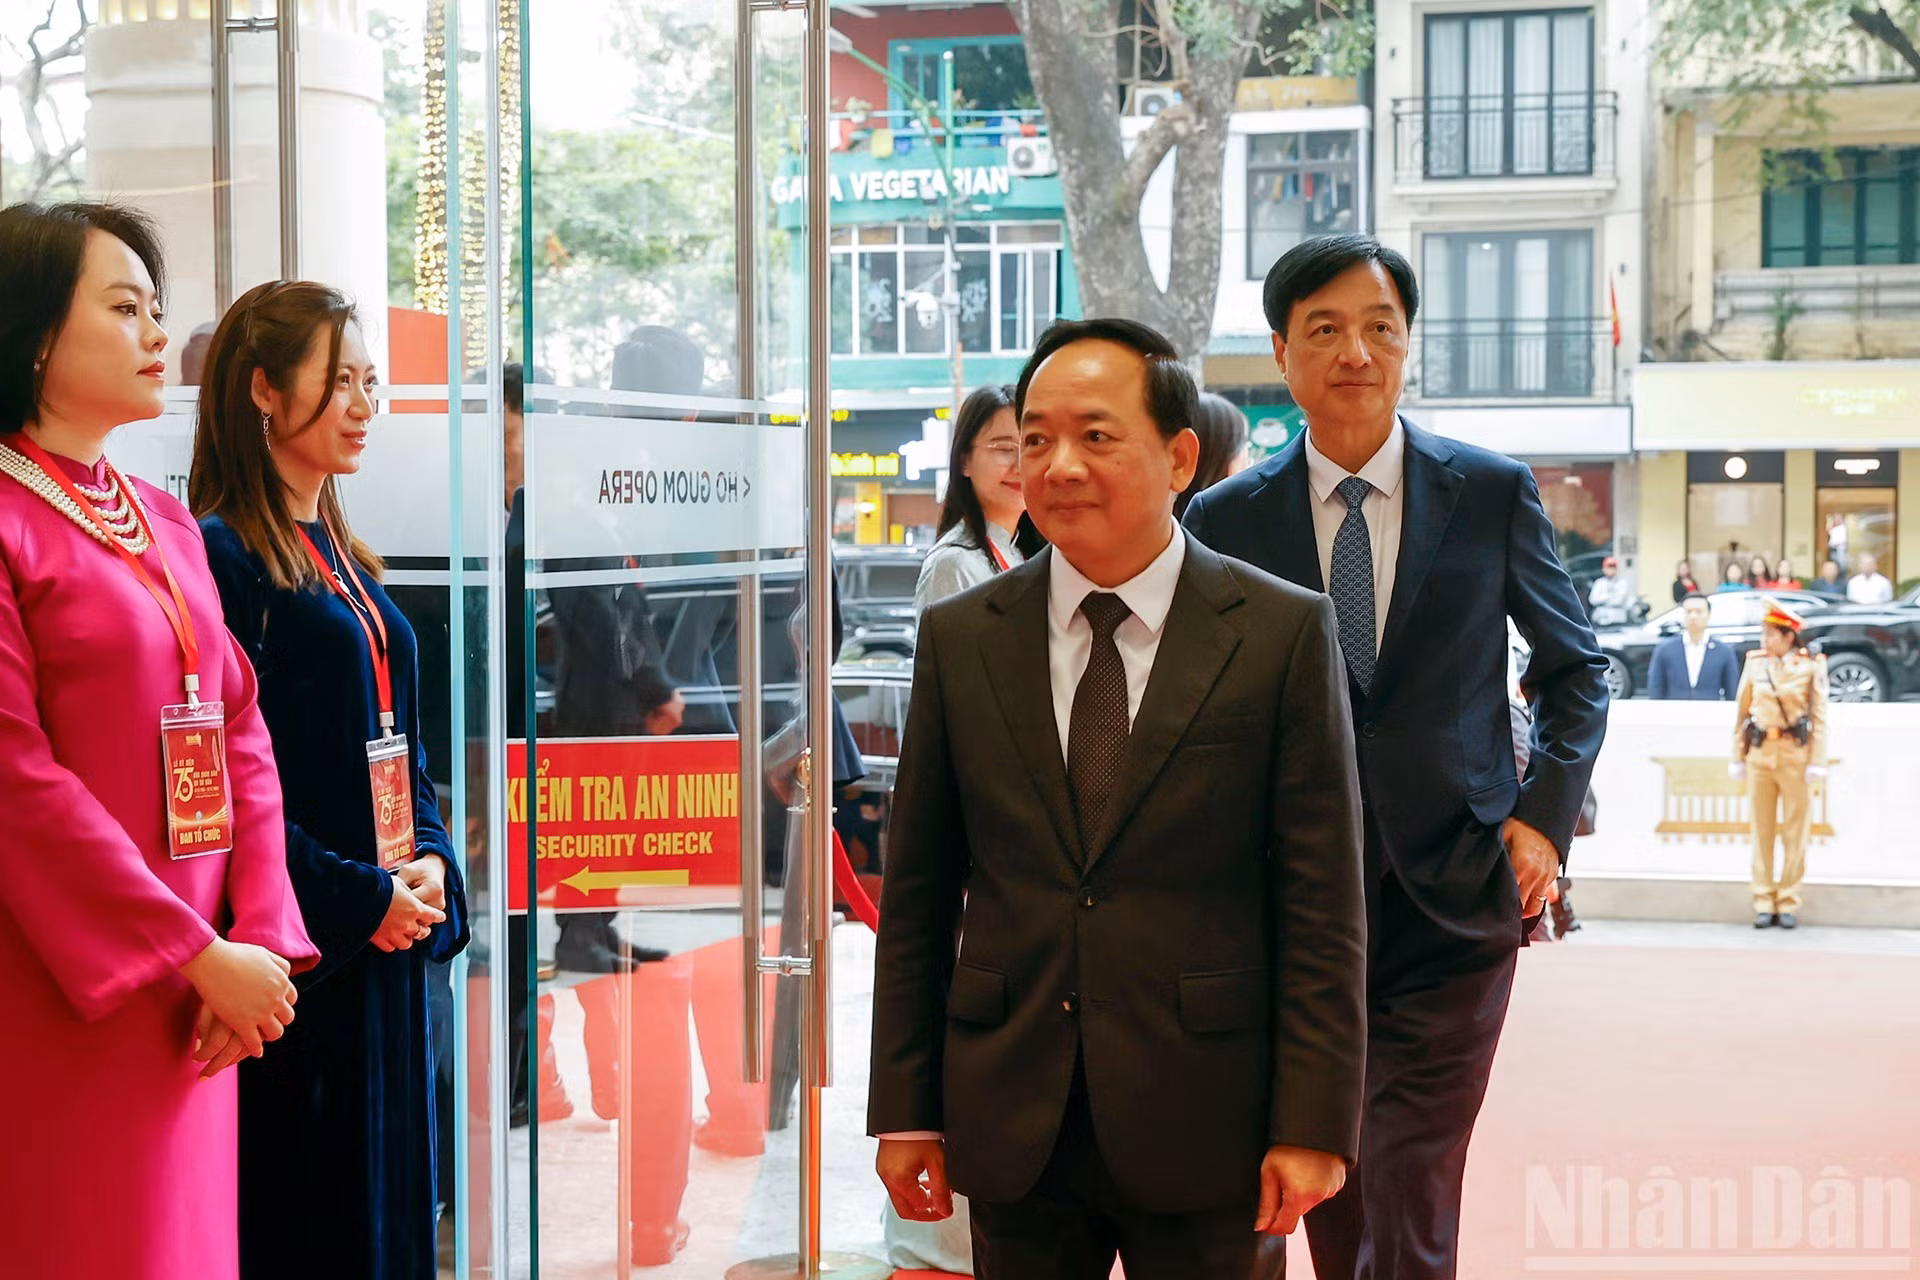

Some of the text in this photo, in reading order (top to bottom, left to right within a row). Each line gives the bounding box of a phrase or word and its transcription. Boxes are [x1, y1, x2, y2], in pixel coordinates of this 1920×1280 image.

[770, 166, 1009, 203] GAA VEGETARIAN
[173, 767, 194, 802] 75
[506, 758, 738, 823] KIỂM TRA AN NINH
[378, 794, 392, 825] 75
[536, 831, 713, 859] SECURITY CHECK
